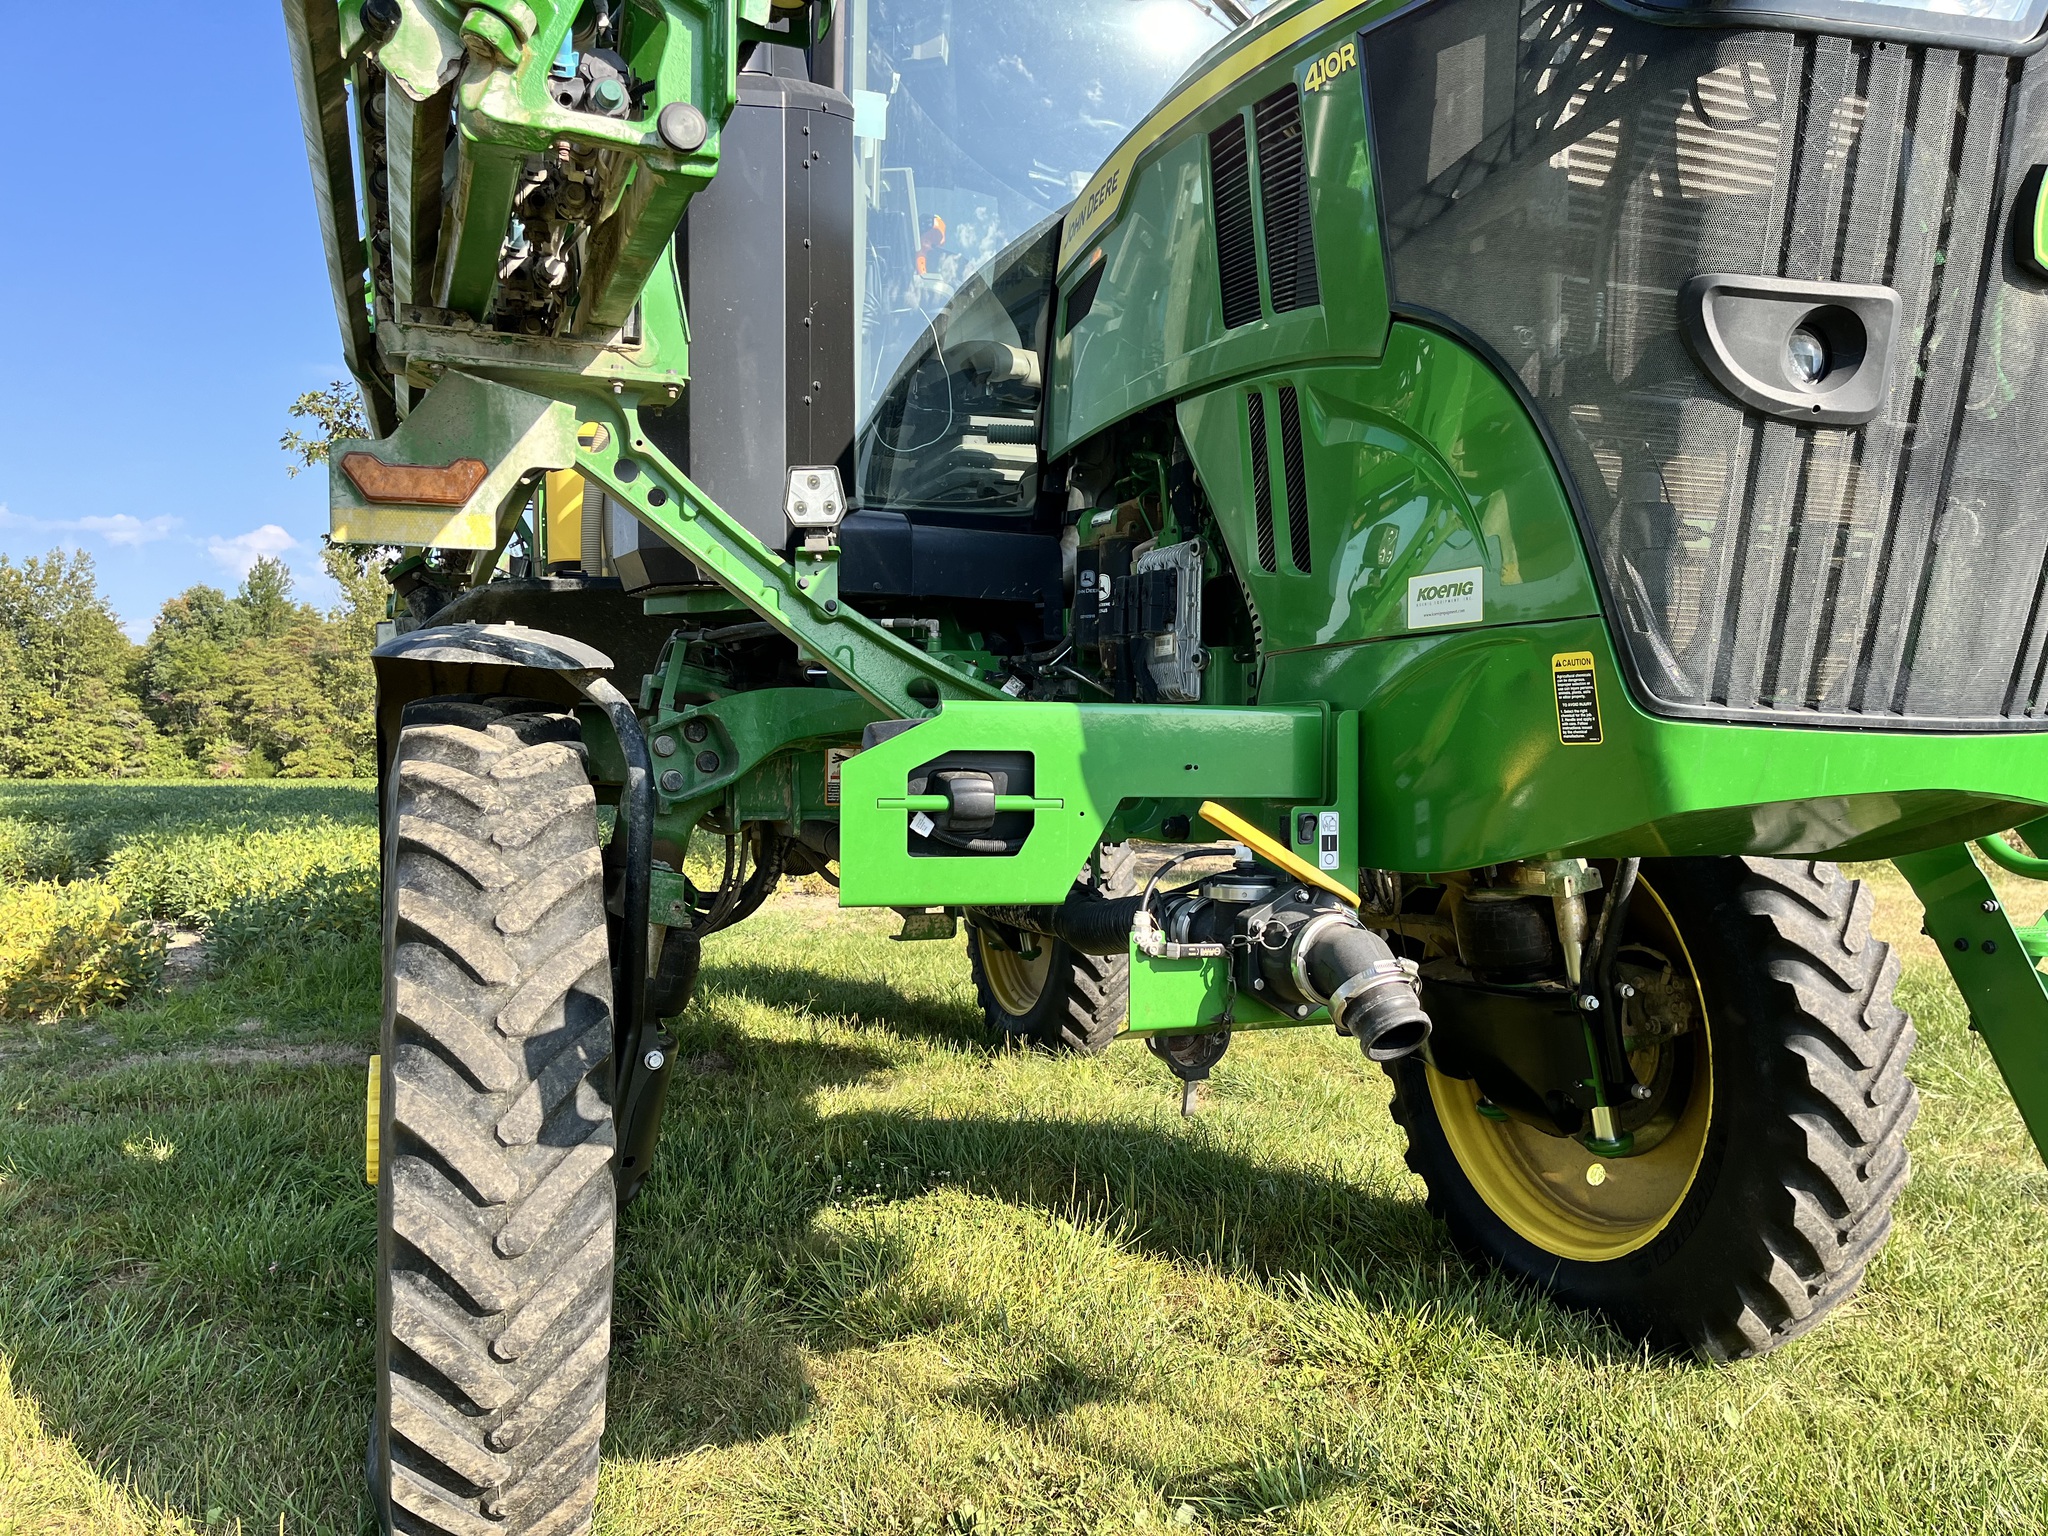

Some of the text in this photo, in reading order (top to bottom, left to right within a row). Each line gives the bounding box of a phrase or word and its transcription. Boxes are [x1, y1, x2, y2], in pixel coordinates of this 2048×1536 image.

[1304, 42, 1357, 93] 410R
[1064, 169, 1120, 250] JOHN DEERE
[1563, 658, 1591, 666] CAUTION
